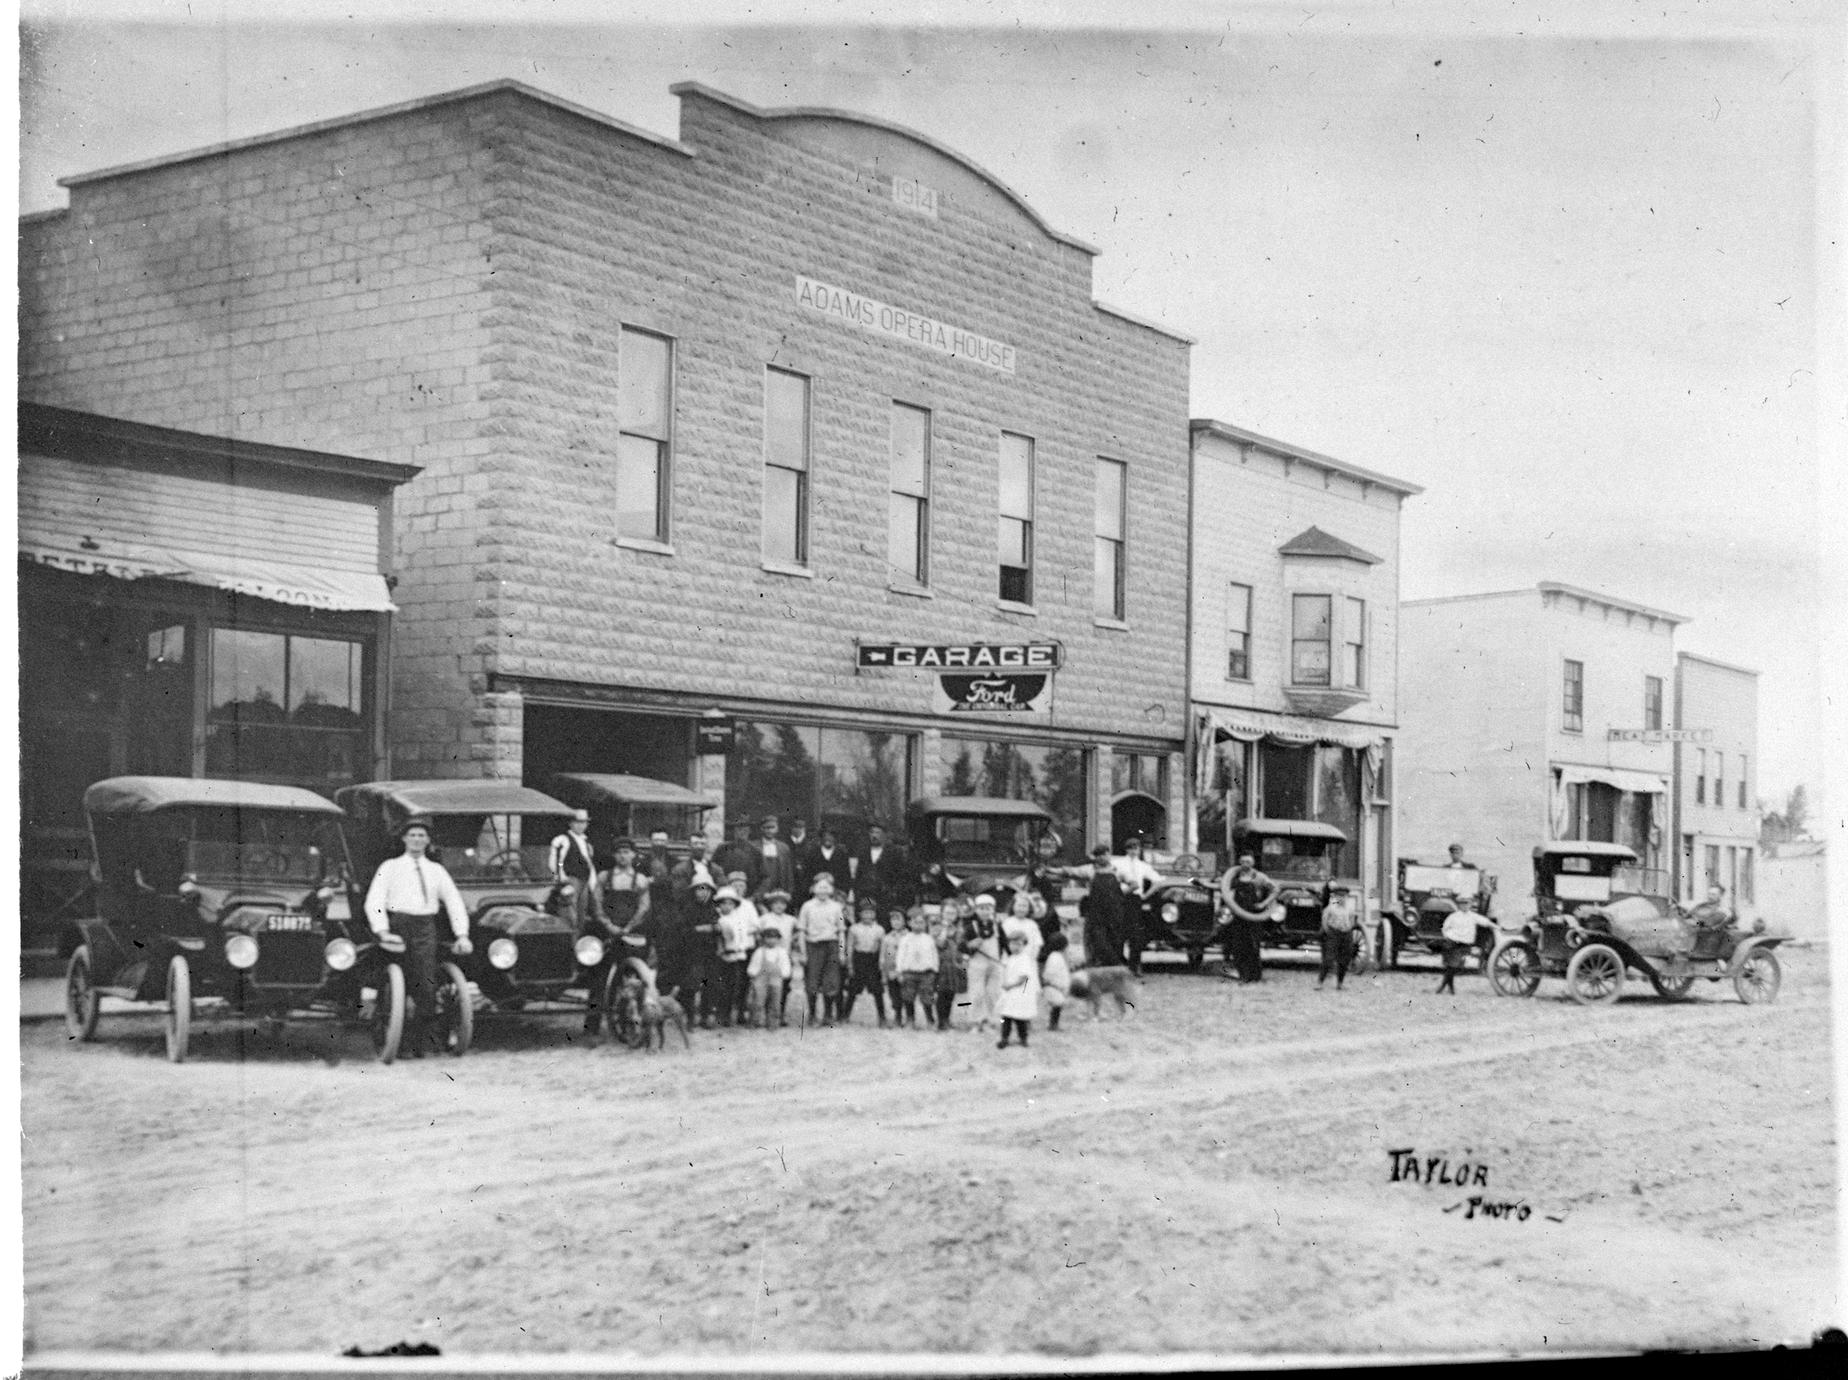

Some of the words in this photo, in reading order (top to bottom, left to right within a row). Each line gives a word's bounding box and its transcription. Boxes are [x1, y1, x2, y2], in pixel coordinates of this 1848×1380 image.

[896, 179, 933, 212] 1914
[800, 282, 873, 324] ADAMS
[881, 308, 947, 350] OPERA
[953, 331, 1013, 370] HOUSE
[893, 647, 1053, 666] GARAGE
[966, 680, 1016, 703] Ford
